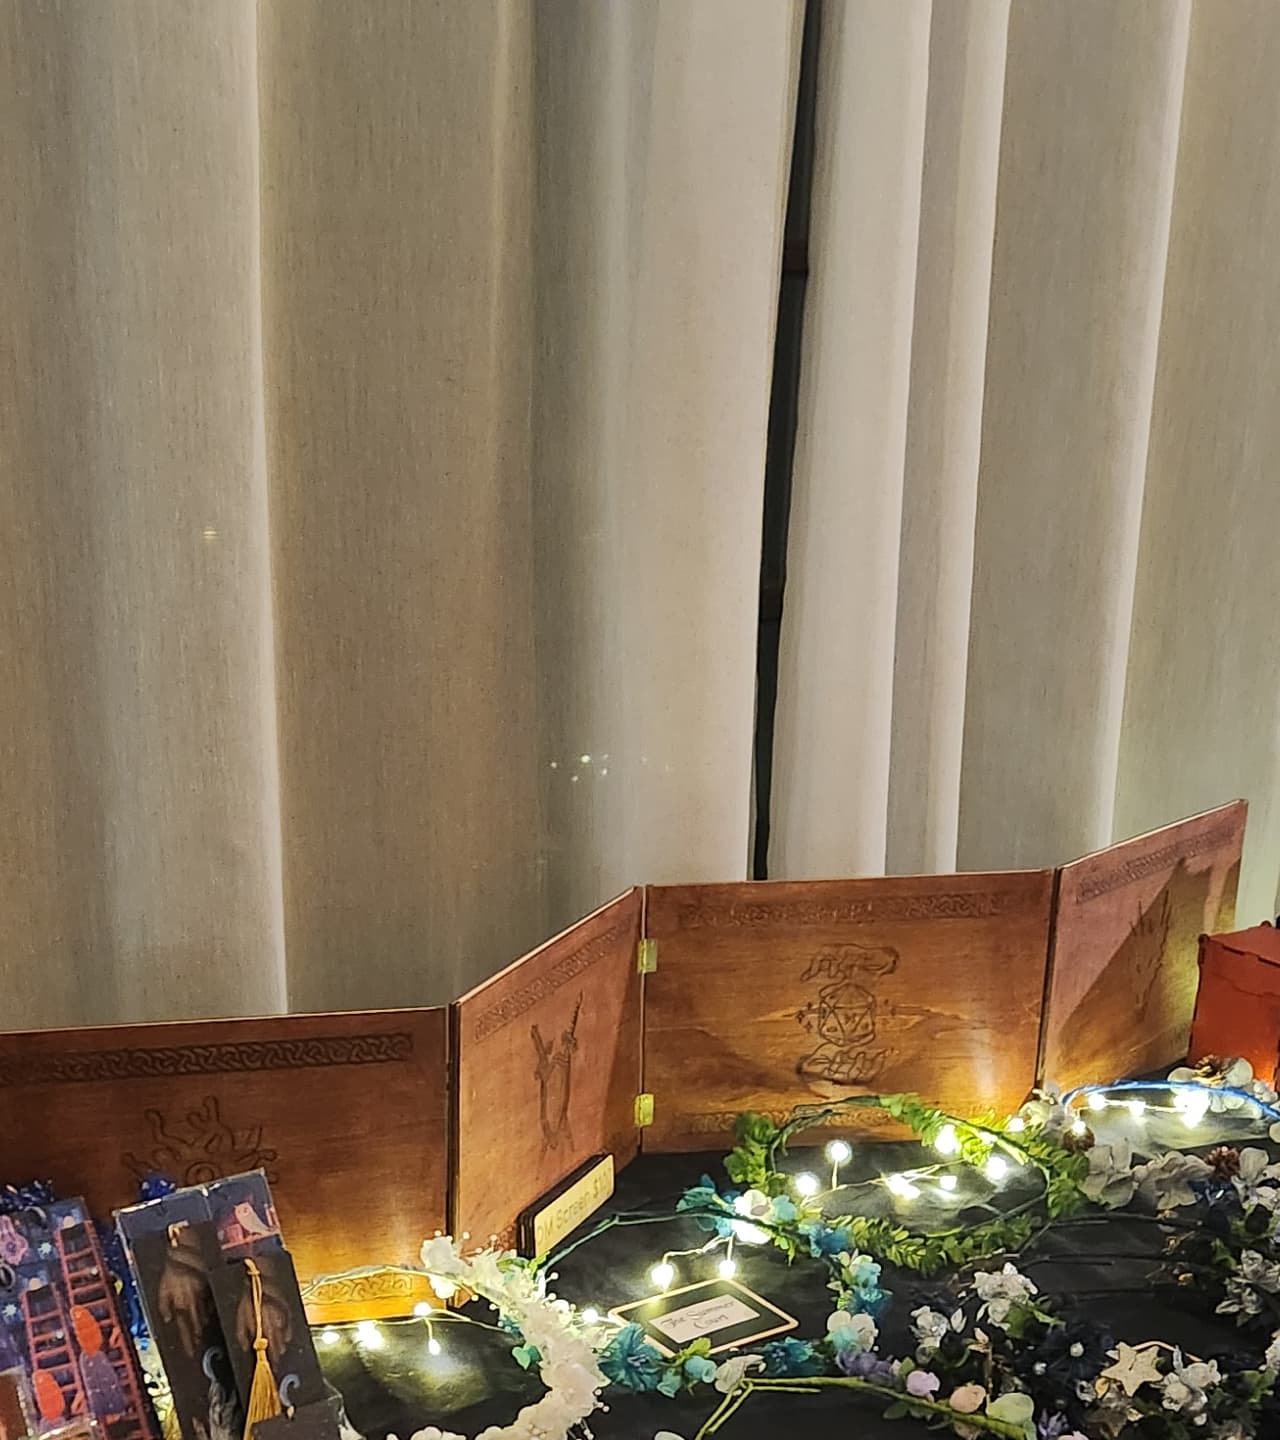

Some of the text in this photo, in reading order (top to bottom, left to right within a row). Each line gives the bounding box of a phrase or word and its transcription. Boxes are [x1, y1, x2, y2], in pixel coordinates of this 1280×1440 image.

[554, 1190, 592, 1230] Screen
[659, 1300, 736, 1331] The Summer
[691, 1313, 731, 1331] Court
